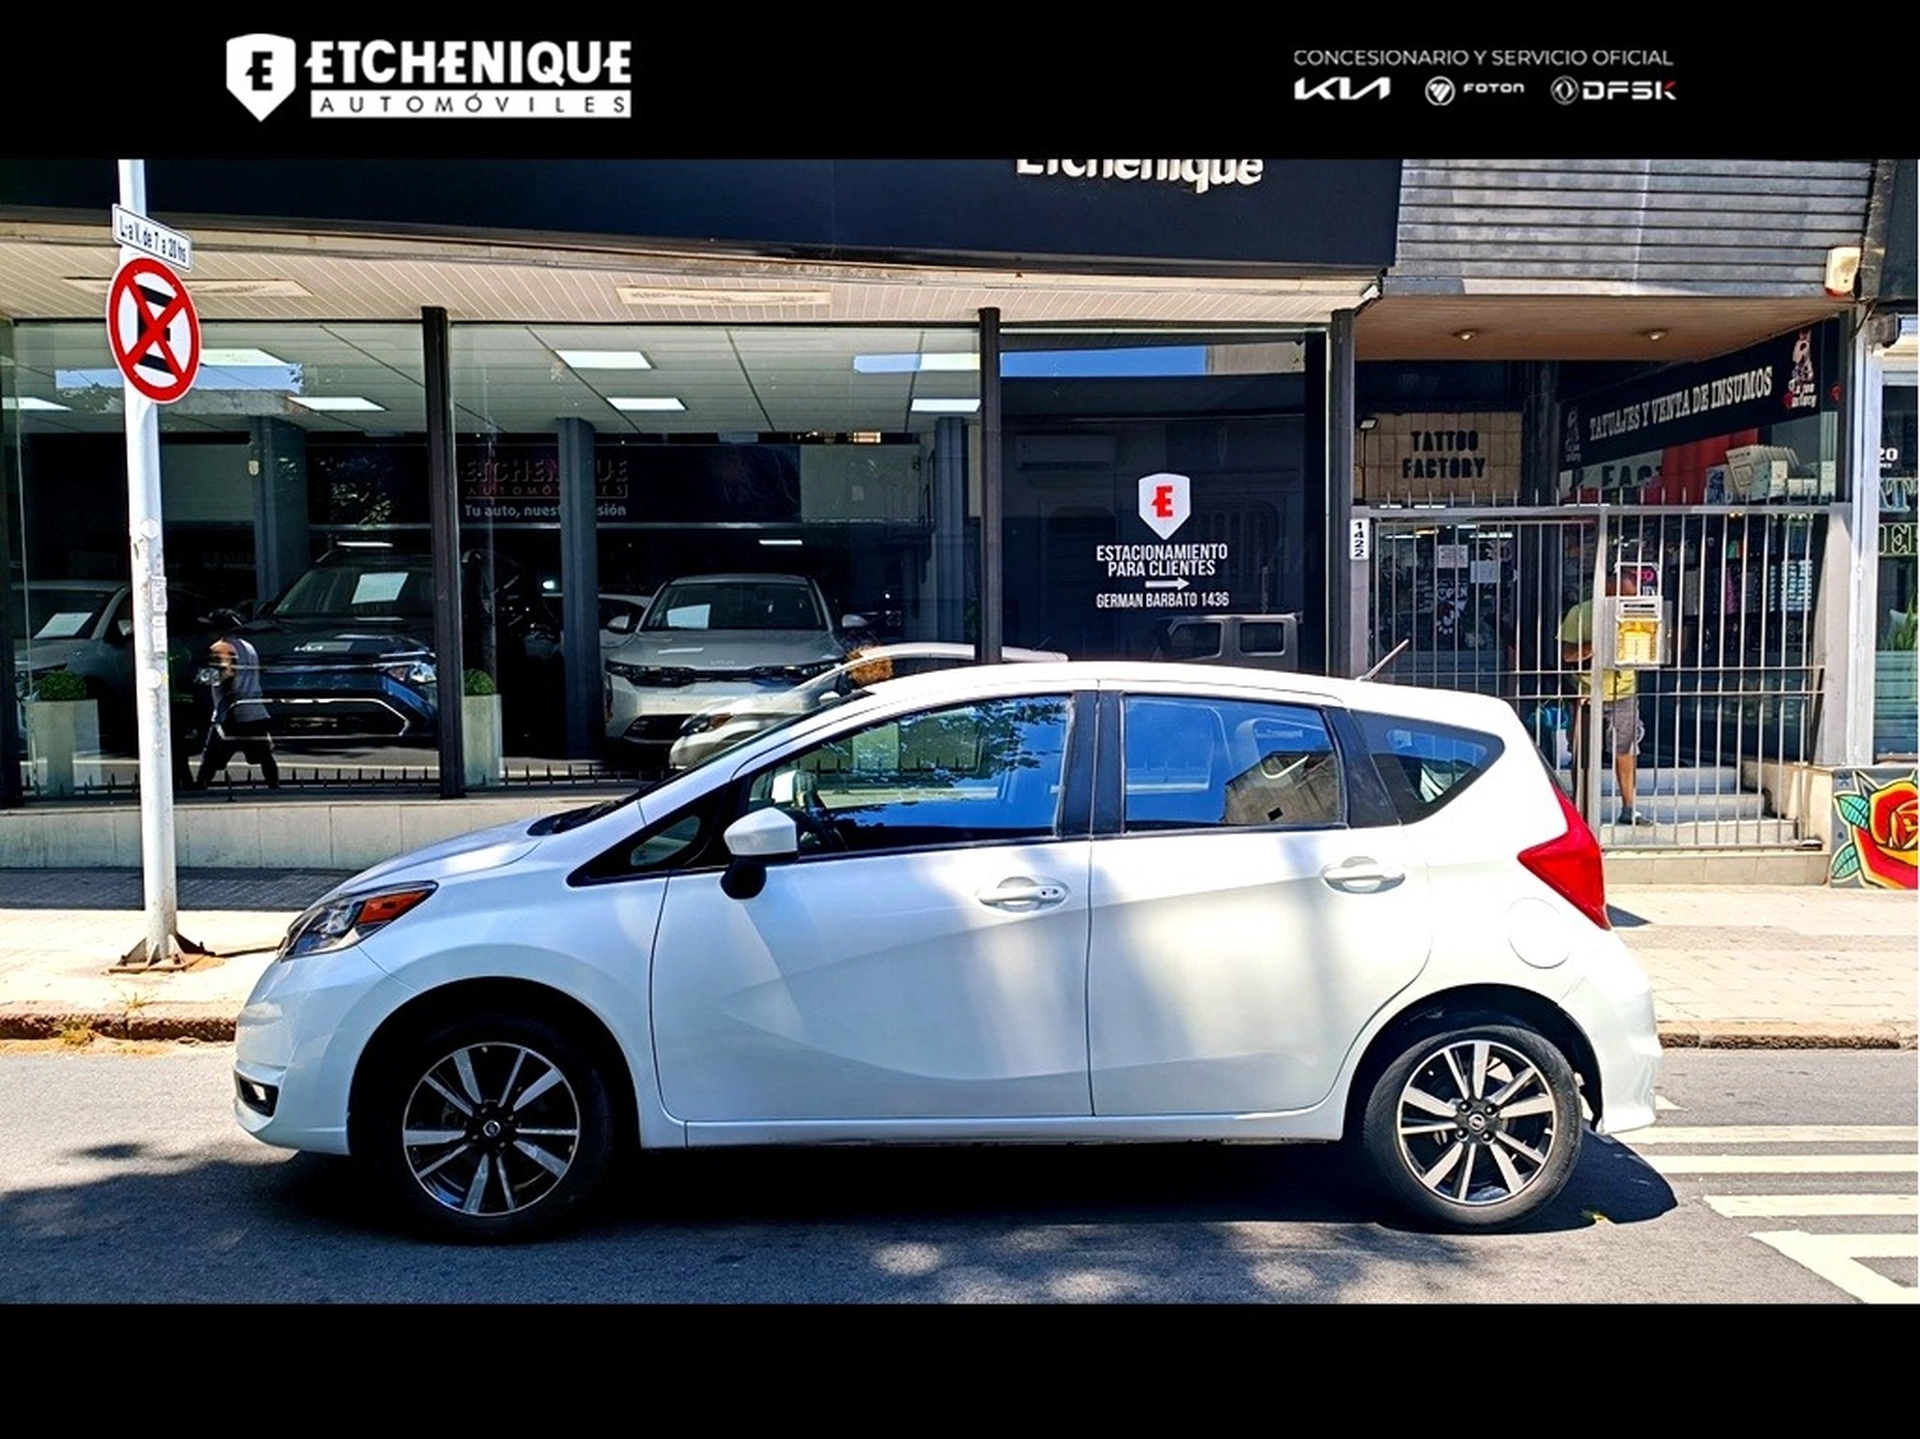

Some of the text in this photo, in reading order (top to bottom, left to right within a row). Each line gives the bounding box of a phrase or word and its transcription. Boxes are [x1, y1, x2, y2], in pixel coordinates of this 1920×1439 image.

[1589, 402, 1641, 441] TATUAJES
[1641, 406, 1650, 428] Y
[1651, 388, 1691, 424] VENTA
[1692, 383, 1710, 415] DE
[1711, 366, 1773, 408] INSUMOS
[1411, 430, 1479, 452] TATTOO
[1402, 457, 1486, 479] FACTORY
[464, 504, 481, 517] Tu
[485, 504, 521, 518] auto,
[1353, 522, 1365, 558] 1422
[1096, 543, 1229, 562] ESTACIONAMIENTO
[1108, 559, 1216, 578] PARA CLIENTES
[1096, 591, 1230, 608] GERMAN BARBATO 1436
